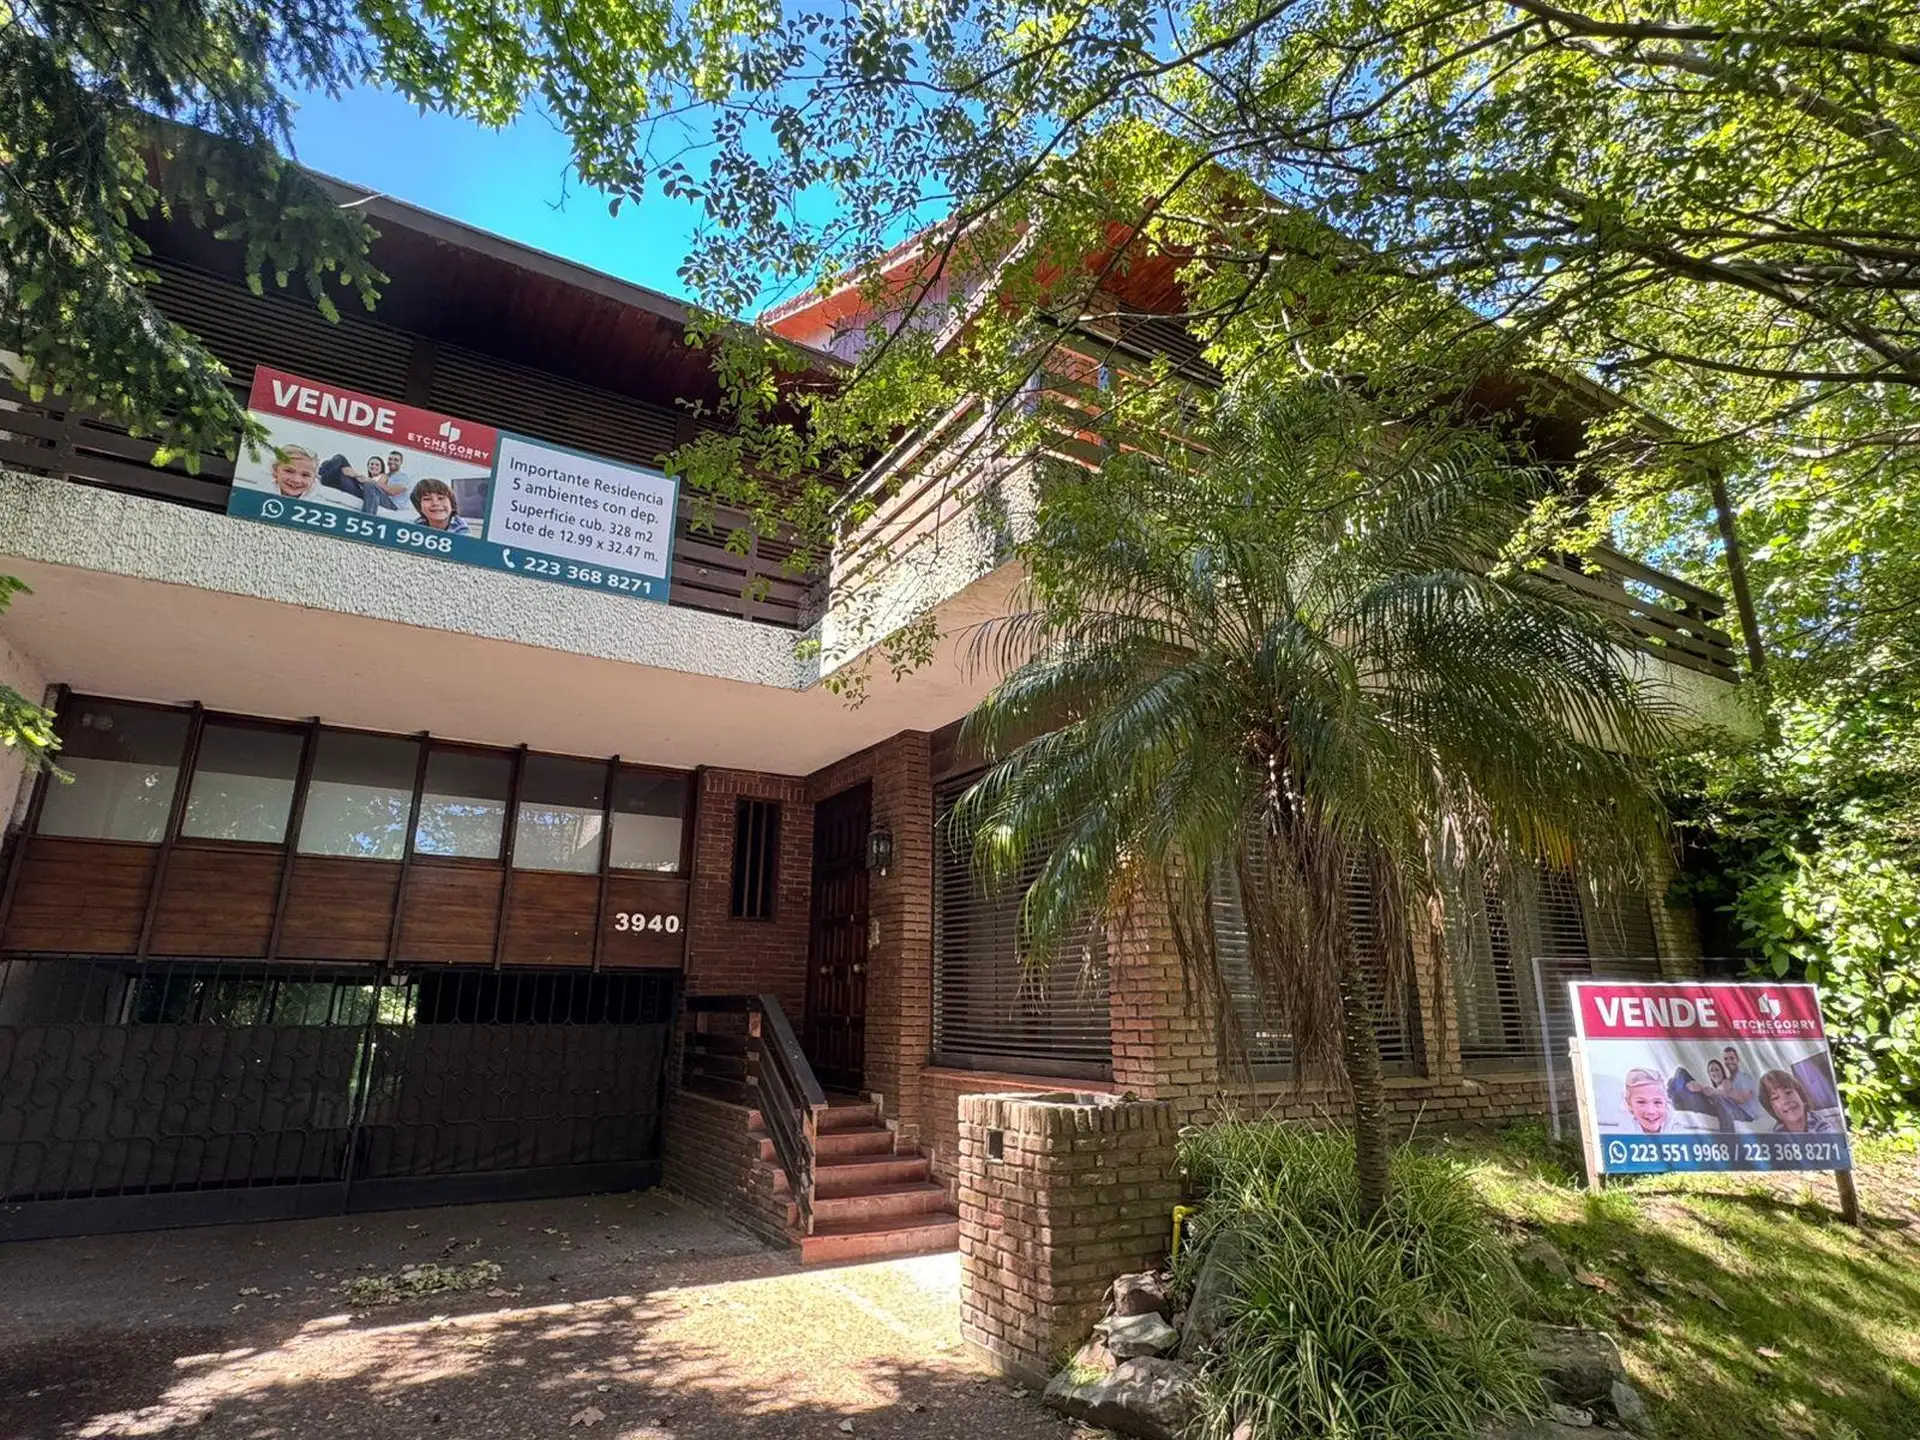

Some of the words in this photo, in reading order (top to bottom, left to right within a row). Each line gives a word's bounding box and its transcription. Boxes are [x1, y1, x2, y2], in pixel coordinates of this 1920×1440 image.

[272, 379, 396, 434] VENDE
[407, 432, 490, 460] ETCHEGORRY
[509, 457, 590, 488] Importante
[594, 478, 664, 507] Residencia
[512, 477, 521, 491] 5
[524, 482, 599, 510] ambientes
[602, 501, 626, 517] con
[630, 506, 659, 525] dep.
[291, 506, 337, 529] 223
[345, 517, 387, 540] 551
[396, 528, 452, 552] 9968
[505, 517, 535, 535] Lote
[538, 524, 555, 540] de
[559, 529, 593, 547] 12.99
[596, 540, 603, 551] x
[607, 540, 641, 558] 32.47
[643, 550, 659, 563] m.
[510, 500, 576, 526] Superficie
[579, 516, 605, 533] cub.
[609, 522, 631, 538] 328
[634, 530, 653, 544] m2
[524, 557, 560, 576] 223
[567, 565, 602, 584] 368
[607, 574, 652, 595] 8271
[614, 912, 680, 933] 3940
[1594, 996, 1719, 1028] VENDE
[1732, 1019, 1816, 1030] ETCHEGORRY
[1630, 1145, 1657, 1162] 223
[1662, 1145, 1690, 1162] 551
[1693, 1145, 1730, 1162] 9968
[1735, 1144, 1739, 1162] /
[1744, 1144, 1770, 1162] 223
[1775, 1144, 1802, 1162] 368
[1806, 1143, 1841, 1161] 8271
